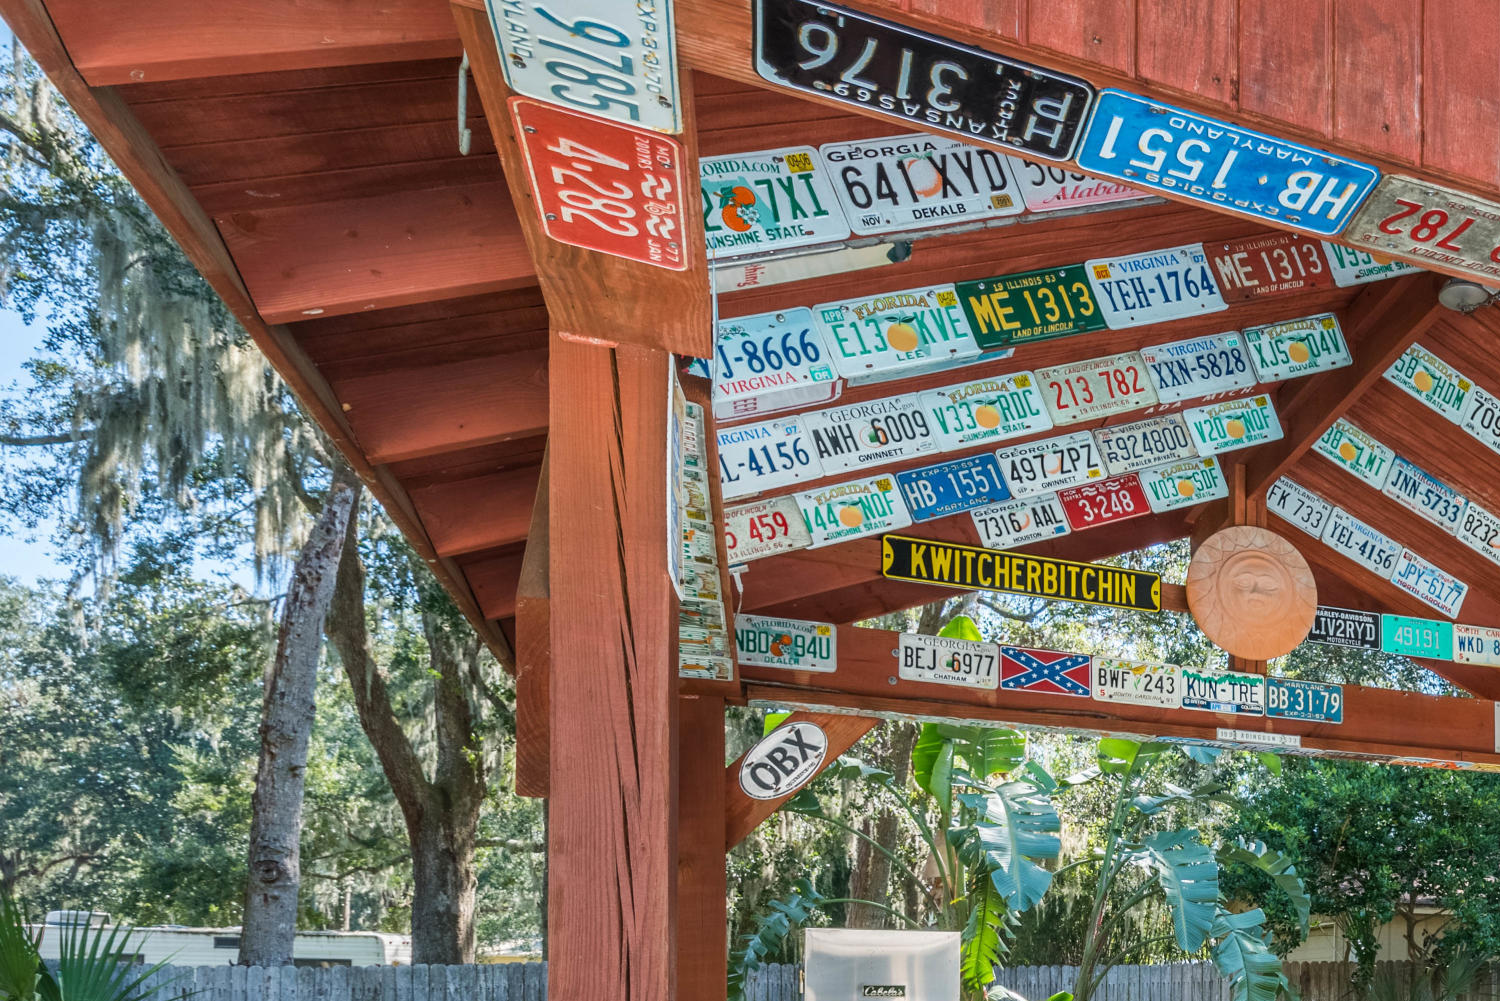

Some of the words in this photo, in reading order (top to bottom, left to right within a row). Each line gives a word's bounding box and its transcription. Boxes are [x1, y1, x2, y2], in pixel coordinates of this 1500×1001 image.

[798, 20, 969, 114] 3176
[879, 96, 1010, 142] KANSAS
[826, 141, 938, 163] GEORGIA
[1168, 115, 1313, 167] MARYLAND
[841, 159, 920, 210] 641
[926, 148, 1008, 201] XYD
[754, 173, 829, 223] 7XI
[911, 203, 967, 221] DEKALB
[1378, 197, 1476, 253] 782
[766, 223, 806, 239] STATE
[1117, 252, 1181, 274] VIRGINIA
[1214, 252, 1259, 291] ME
[1260, 243, 1323, 283] 1313
[1358, 263, 1394, 279] SUNSHINE
[1006, 276, 1043, 291] ILLINOIS
[1099, 265, 1217, 313] YEH-1764
[852, 293, 931, 320] FLORIDA
[968, 291, 1022, 335] ME
[1023, 281, 1095, 326] 1313
[831, 318, 889, 358] E13
[912, 305, 969, 345] KVE
[1043, 320, 1074, 334] LINCOLN
[1266, 320, 1317, 341] FLORIDA
[896, 349, 925, 362] LEE
[1166, 339, 1217, 357] VIRGINIA
[1253, 338, 1290, 369] XJS
[1150, 347, 1247, 390] XXN-5828
[1288, 361, 1321, 374] DUVAL
[1408, 346, 1453, 382] FLORIDA
[718, 371, 798, 396] VIRGINIA
[947, 381, 1011, 404] FLORIDA
[1049, 375, 1095, 410] 213
[1097, 365, 1146, 399] 782
[1394, 373, 1425, 397] SUNSHINE
[932, 401, 977, 436] V33
[999, 390, 1041, 423] RDC
[1205, 400, 1252, 419] FLORIDA
[811, 421, 860, 459] AWH
[870, 409, 931, 446] 6009
[961, 427, 1000, 443] SUNSHINE
[1001, 422, 1027, 434] STATE
[1118, 420, 1160, 434] VIRGINIA
[1193, 416, 1228, 444] V20
[857, 447, 905, 464] GWINNETT
[999, 441, 1060, 460] GEORGIA
[1115, 424, 1189, 462] 924800
[1009, 454, 1049, 486] 497
[1052, 443, 1099, 475] ZPZ
[1159, 462, 1201, 480] FLORIDA
[812, 483, 872, 506] FLORIDA
[1041, 476, 1077, 489] GWINNETT
[1277, 477, 1317, 503] MARYLAND
[1411, 469, 1449, 499] VIRGINIA
[935, 495, 989, 513] MARYLAND
[1390, 469, 1461, 523] JNN-5733
[973, 501, 1028, 519] GEORGIA
[978, 511, 1022, 541] 7316
[1031, 503, 1064, 528] AAL
[1291, 498, 1324, 529] 733
[749, 511, 789, 543] 459
[826, 526, 863, 541] SUNSHINE
[863, 521, 888, 533] STATE
[1012, 531, 1043, 545] HOUSTON
[1349, 519, 1384, 545] VIRGINIA
[1463, 513, 1499, 549] 8232
[1328, 519, 1395, 570] YEL-4156
[910, 543, 1137, 606] KWITCHERBITCHIN
[1397, 561, 1463, 607] JPY-6177
[1395, 577, 1421, 598] NORTH
[1420, 591, 1453, 615] CAROLINA
[1311, 616, 1376, 642] LIV2RYD
[1326, 636, 1362, 647] MOTORCYCLE
[1393, 626, 1441, 650] 49191
[794, 634, 831, 660] 94U
[1457, 635, 1484, 654] WKD
[763, 655, 801, 666] DEALER
[903, 645, 937, 671] BEJ
[951, 651, 995, 678] 6977
[933, 673, 968, 683] CHATHAM
[1098, 667, 1130, 690] BWF
[1143, 673, 1176, 695] 243
[1186, 676, 1260, 703] KUN-TRE
[749, 727, 822, 792] OBX
[864, 986, 906, 997] Cabela's
